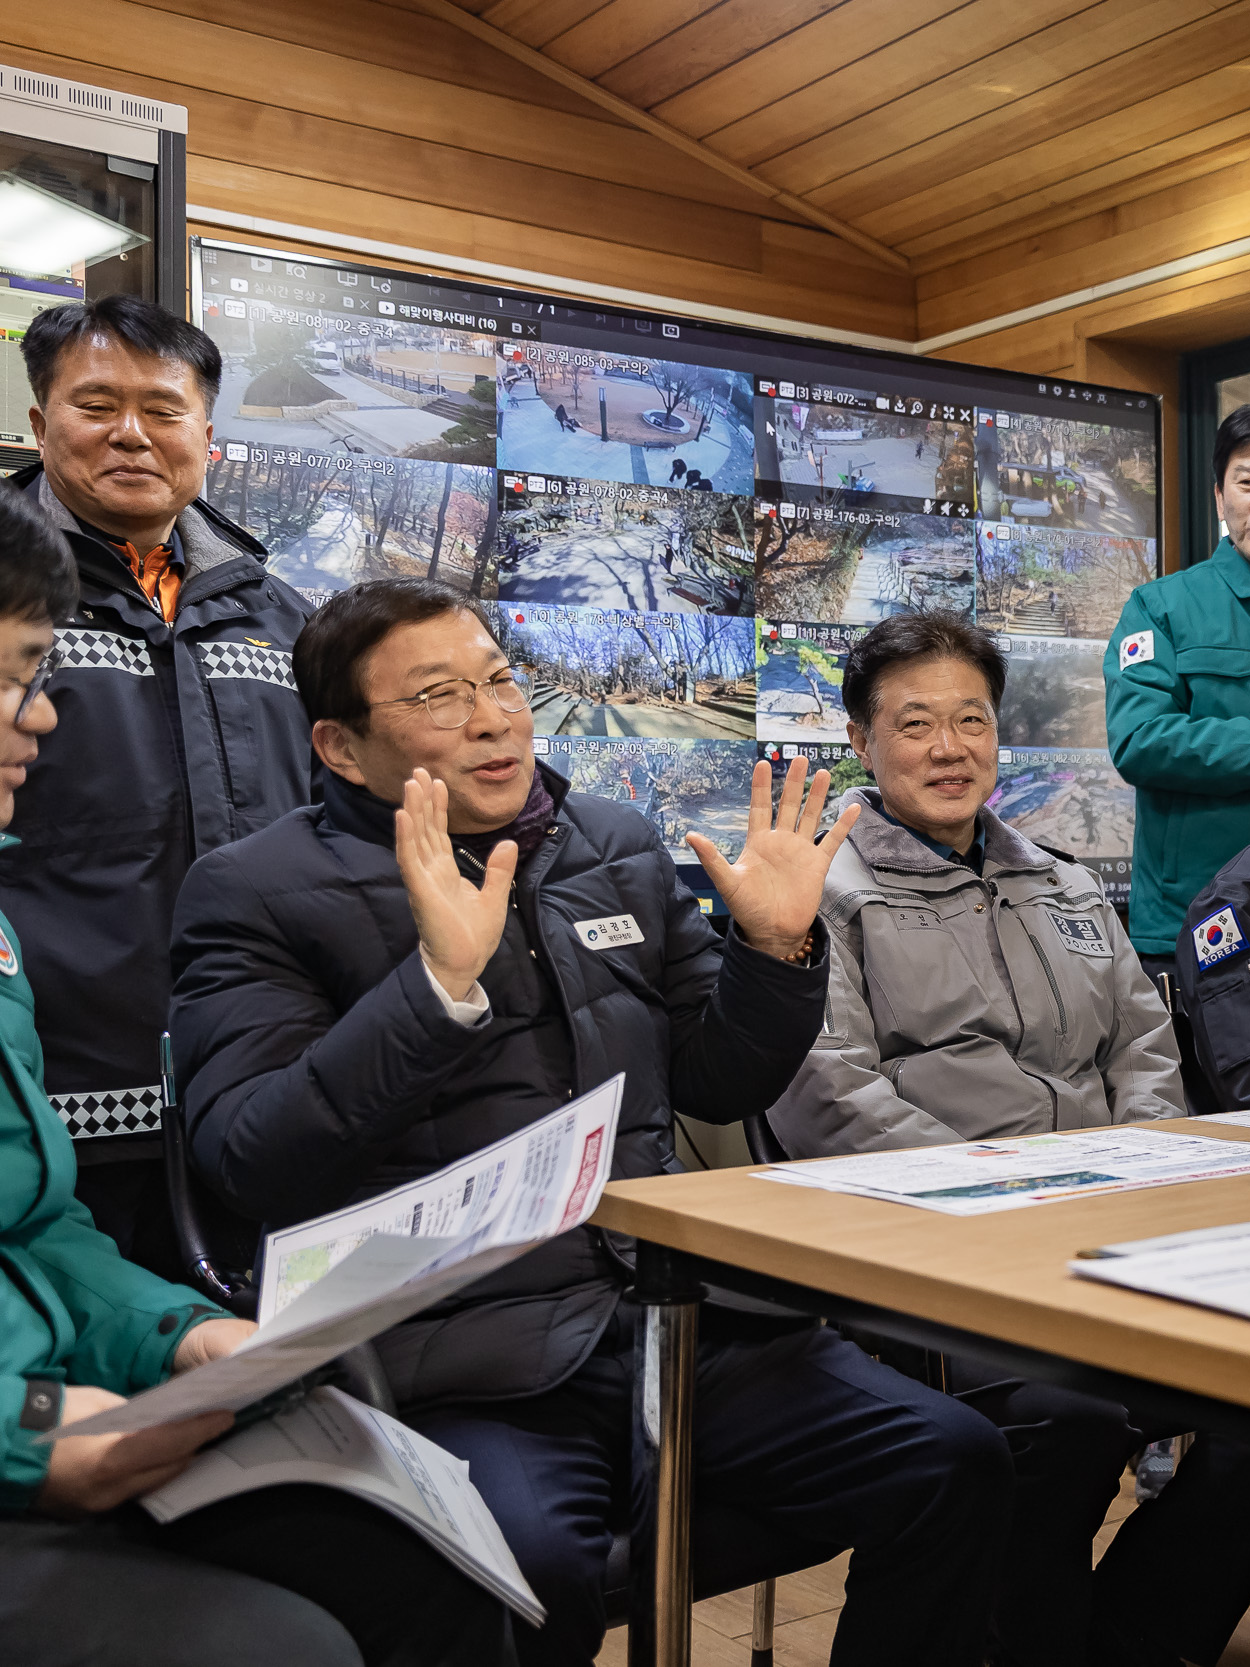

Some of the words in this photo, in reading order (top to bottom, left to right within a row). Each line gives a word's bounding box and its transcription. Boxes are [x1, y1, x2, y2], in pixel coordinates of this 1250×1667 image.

[254, 282, 289, 298] 실시간
[294, 289, 316, 302] 영상
[318, 294, 325, 303] 2
[497, 298, 503, 307] 1
[250, 307, 265, 321] [1]
[271, 310, 394, 339] 공원-081-02-중곡4
[399, 305, 475, 327] 해맞이행사대비
[478, 317, 497, 331] (16)
[526, 346, 541, 361] [2]
[545, 350, 649, 376] 공원-085-03-구의2
[796, 386, 809, 399] [3]
[251, 449, 267, 463] [5]
[272, 450, 396, 476] 공원-077-02-구의2
[547, 481, 561, 494] [6]
[565, 482, 668, 504] 공원-078-02-중곡4
[797, 507, 809, 520] [7]
[813, 508, 900, 528] 공원-176-03-구의2
[1011, 529, 1021, 541] [8]
[529, 610, 550, 623] [10]
[550, 743, 571, 754] [14]
[576, 741, 677, 755] 공원-179-03-구의2
[800, 747, 818, 759] [15]
[1053, 915, 1097, 940] 경찰
[1067, 937, 1105, 952] POLICE
[1204, 944, 1240, 965] KOREA
